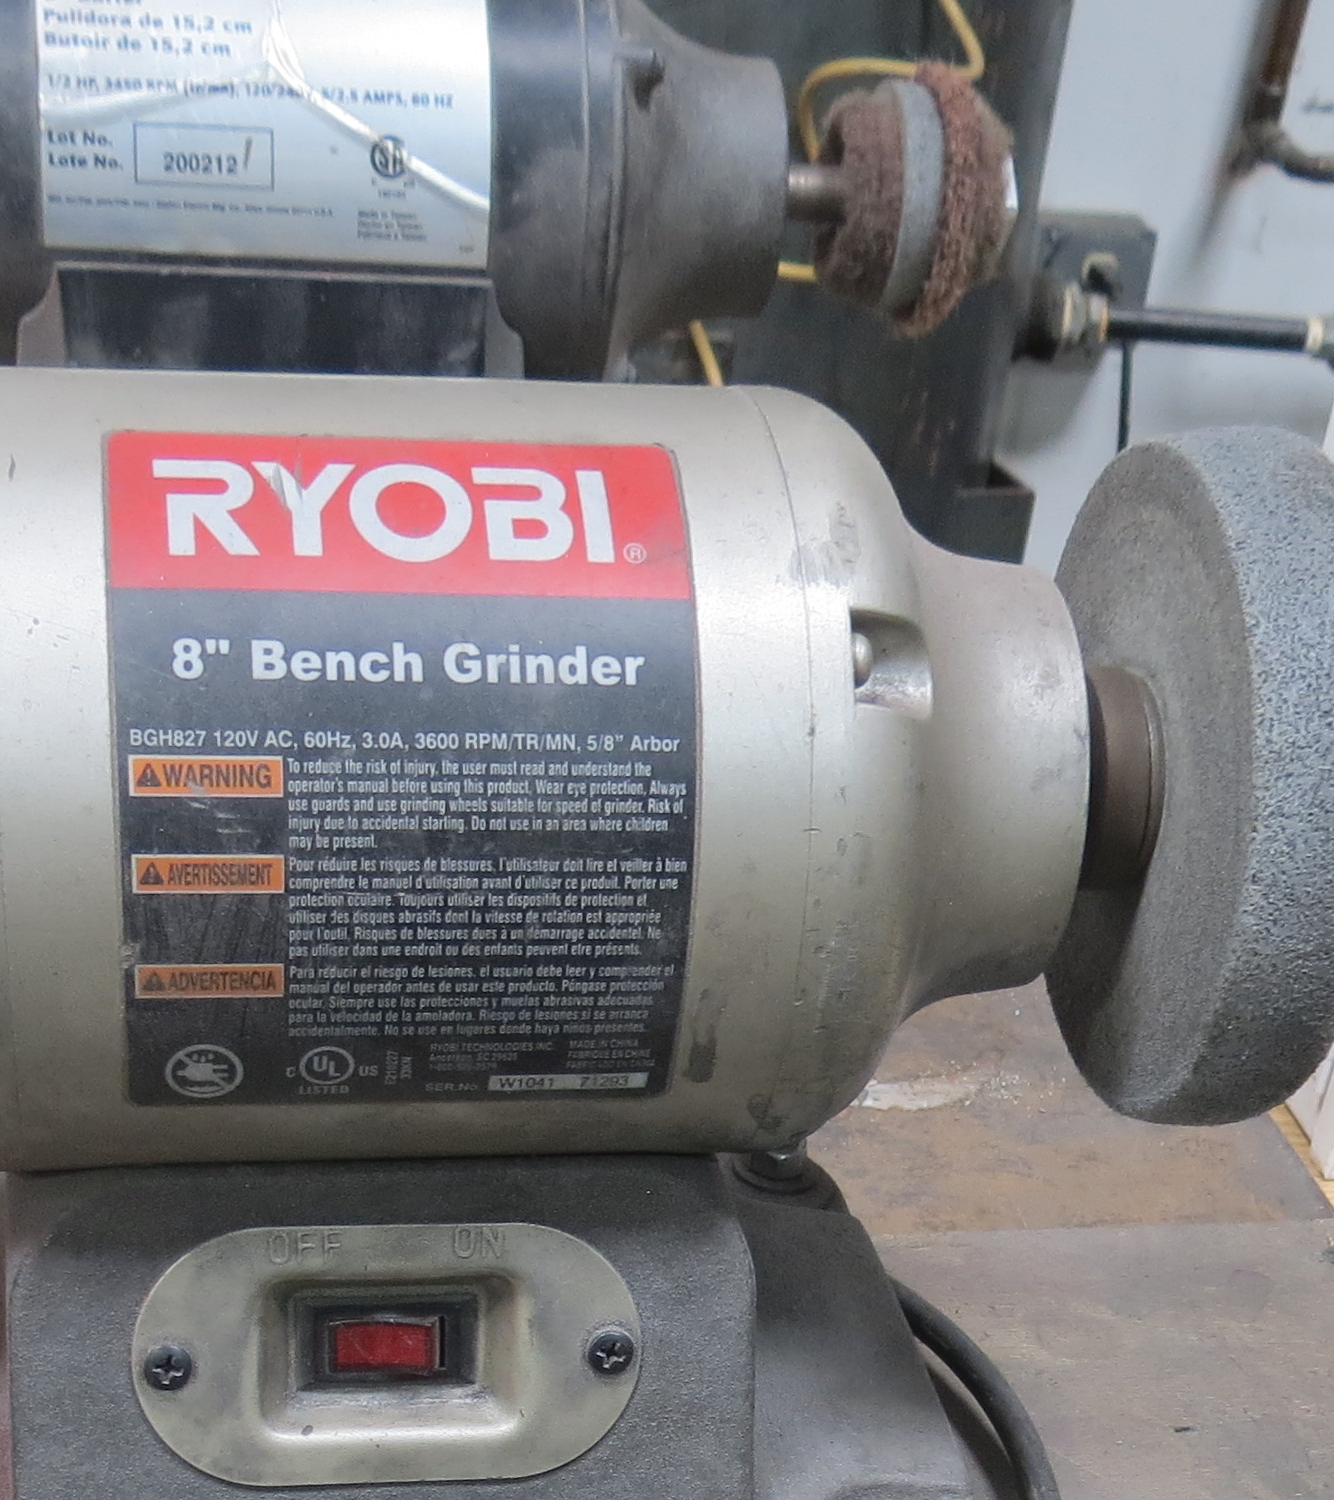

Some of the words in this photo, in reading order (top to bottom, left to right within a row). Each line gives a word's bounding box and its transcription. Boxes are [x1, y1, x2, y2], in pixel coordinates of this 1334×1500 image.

[222, 20, 252, 34] cm
[44, 31, 109, 50] Butoir
[201, 44, 231, 56] cm
[47, 130, 75, 146] Lot
[83, 132, 113, 148] No.
[48, 154, 87, 169] Lote
[95, 156, 123, 171] No.
[163, 152, 237, 174] 200212
[152, 458, 615, 564] RYOBI
[171, 636, 230, 680] 8"
[250, 639, 424, 683] Bench
[443, 644, 646, 686] Grinder
[129, 729, 206, 747] BGH827
[214, 731, 258, 748] 120V
[265, 731, 298, 750] AC,
[304, 731, 356, 750] 60Hz,
[362, 731, 409, 750] 3.0A,
[415, 733, 459, 749] 3600
[466, 732, 581, 753] RPM/TR/MN,
[630, 735, 680, 752] Arbor
[164, 764, 272, 788] WARNING
[287, 758, 300, 773] To
[303, 759, 341, 774] reduce
[346, 760, 362, 774] the
[368, 760, 387, 774] risk
[390, 761, 400, 774] of
[441, 761, 459, 775] the
[462, 764, 486, 775] user
[490, 762, 517, 776] must
[520, 761, 545, 776] read
[548, 762, 568, 776] and
[571, 762, 631, 776] understand
[635, 763, 652, 777] the
[288, 778, 344, 795] operator's
[347, 779, 388, 793] manual
[392, 778, 426, 793] before
[430, 780, 460, 796] using
[464, 779, 484, 793] this
[536, 780, 564, 794] Wear
[567, 783, 586, 797] eye
[649, 780, 686, 798] Always
[288, 799, 308, 811] use
[312, 797, 350, 814] guards
[353, 798, 373, 811] and
[377, 799, 397, 812] use
[400, 798, 445, 814] grinding
[449, 799, 487, 812] wheels
[490, 798, 534, 813] suitable
[538, 799, 551, 813] for
[556, 798, 587, 814] speed
[591, 799, 601, 813] of
[648, 799, 670, 813] Risk
[673, 799, 683, 813] of
[288, 816, 319, 832] injury
[324, 816, 344, 830] due
[348, 816, 358, 830] to
[362, 816, 419, 830] accidental
[471, 817, 486, 831] Do
[489, 817, 507, 830] not
[510, 819, 529, 831] use
[532, 817, 542, 830] in
[546, 819, 559, 831] an
[562, 819, 586, 831] area
[590, 817, 622, 831] where
[626, 817, 668, 832] children
[289, 836, 312, 850] may
[317, 834, 329, 848] be
[168, 863, 272, 886] AVERTISSEMENT
[289, 858, 314, 871] Pour
[360, 858, 377, 871] les
[380, 858, 420, 874] risques
[424, 858, 436, 871] de
[563, 858, 583, 871] doit
[587, 858, 603, 871] lire
[607, 859, 617, 871] et
[666, 858, 687, 871] bien
[169, 971, 276, 991] ADVERTENCIA
[499, 1077, 554, 1089] W1041
[268, 1229, 343, 1265] OFF
[452, 1226, 506, 1260] ON
